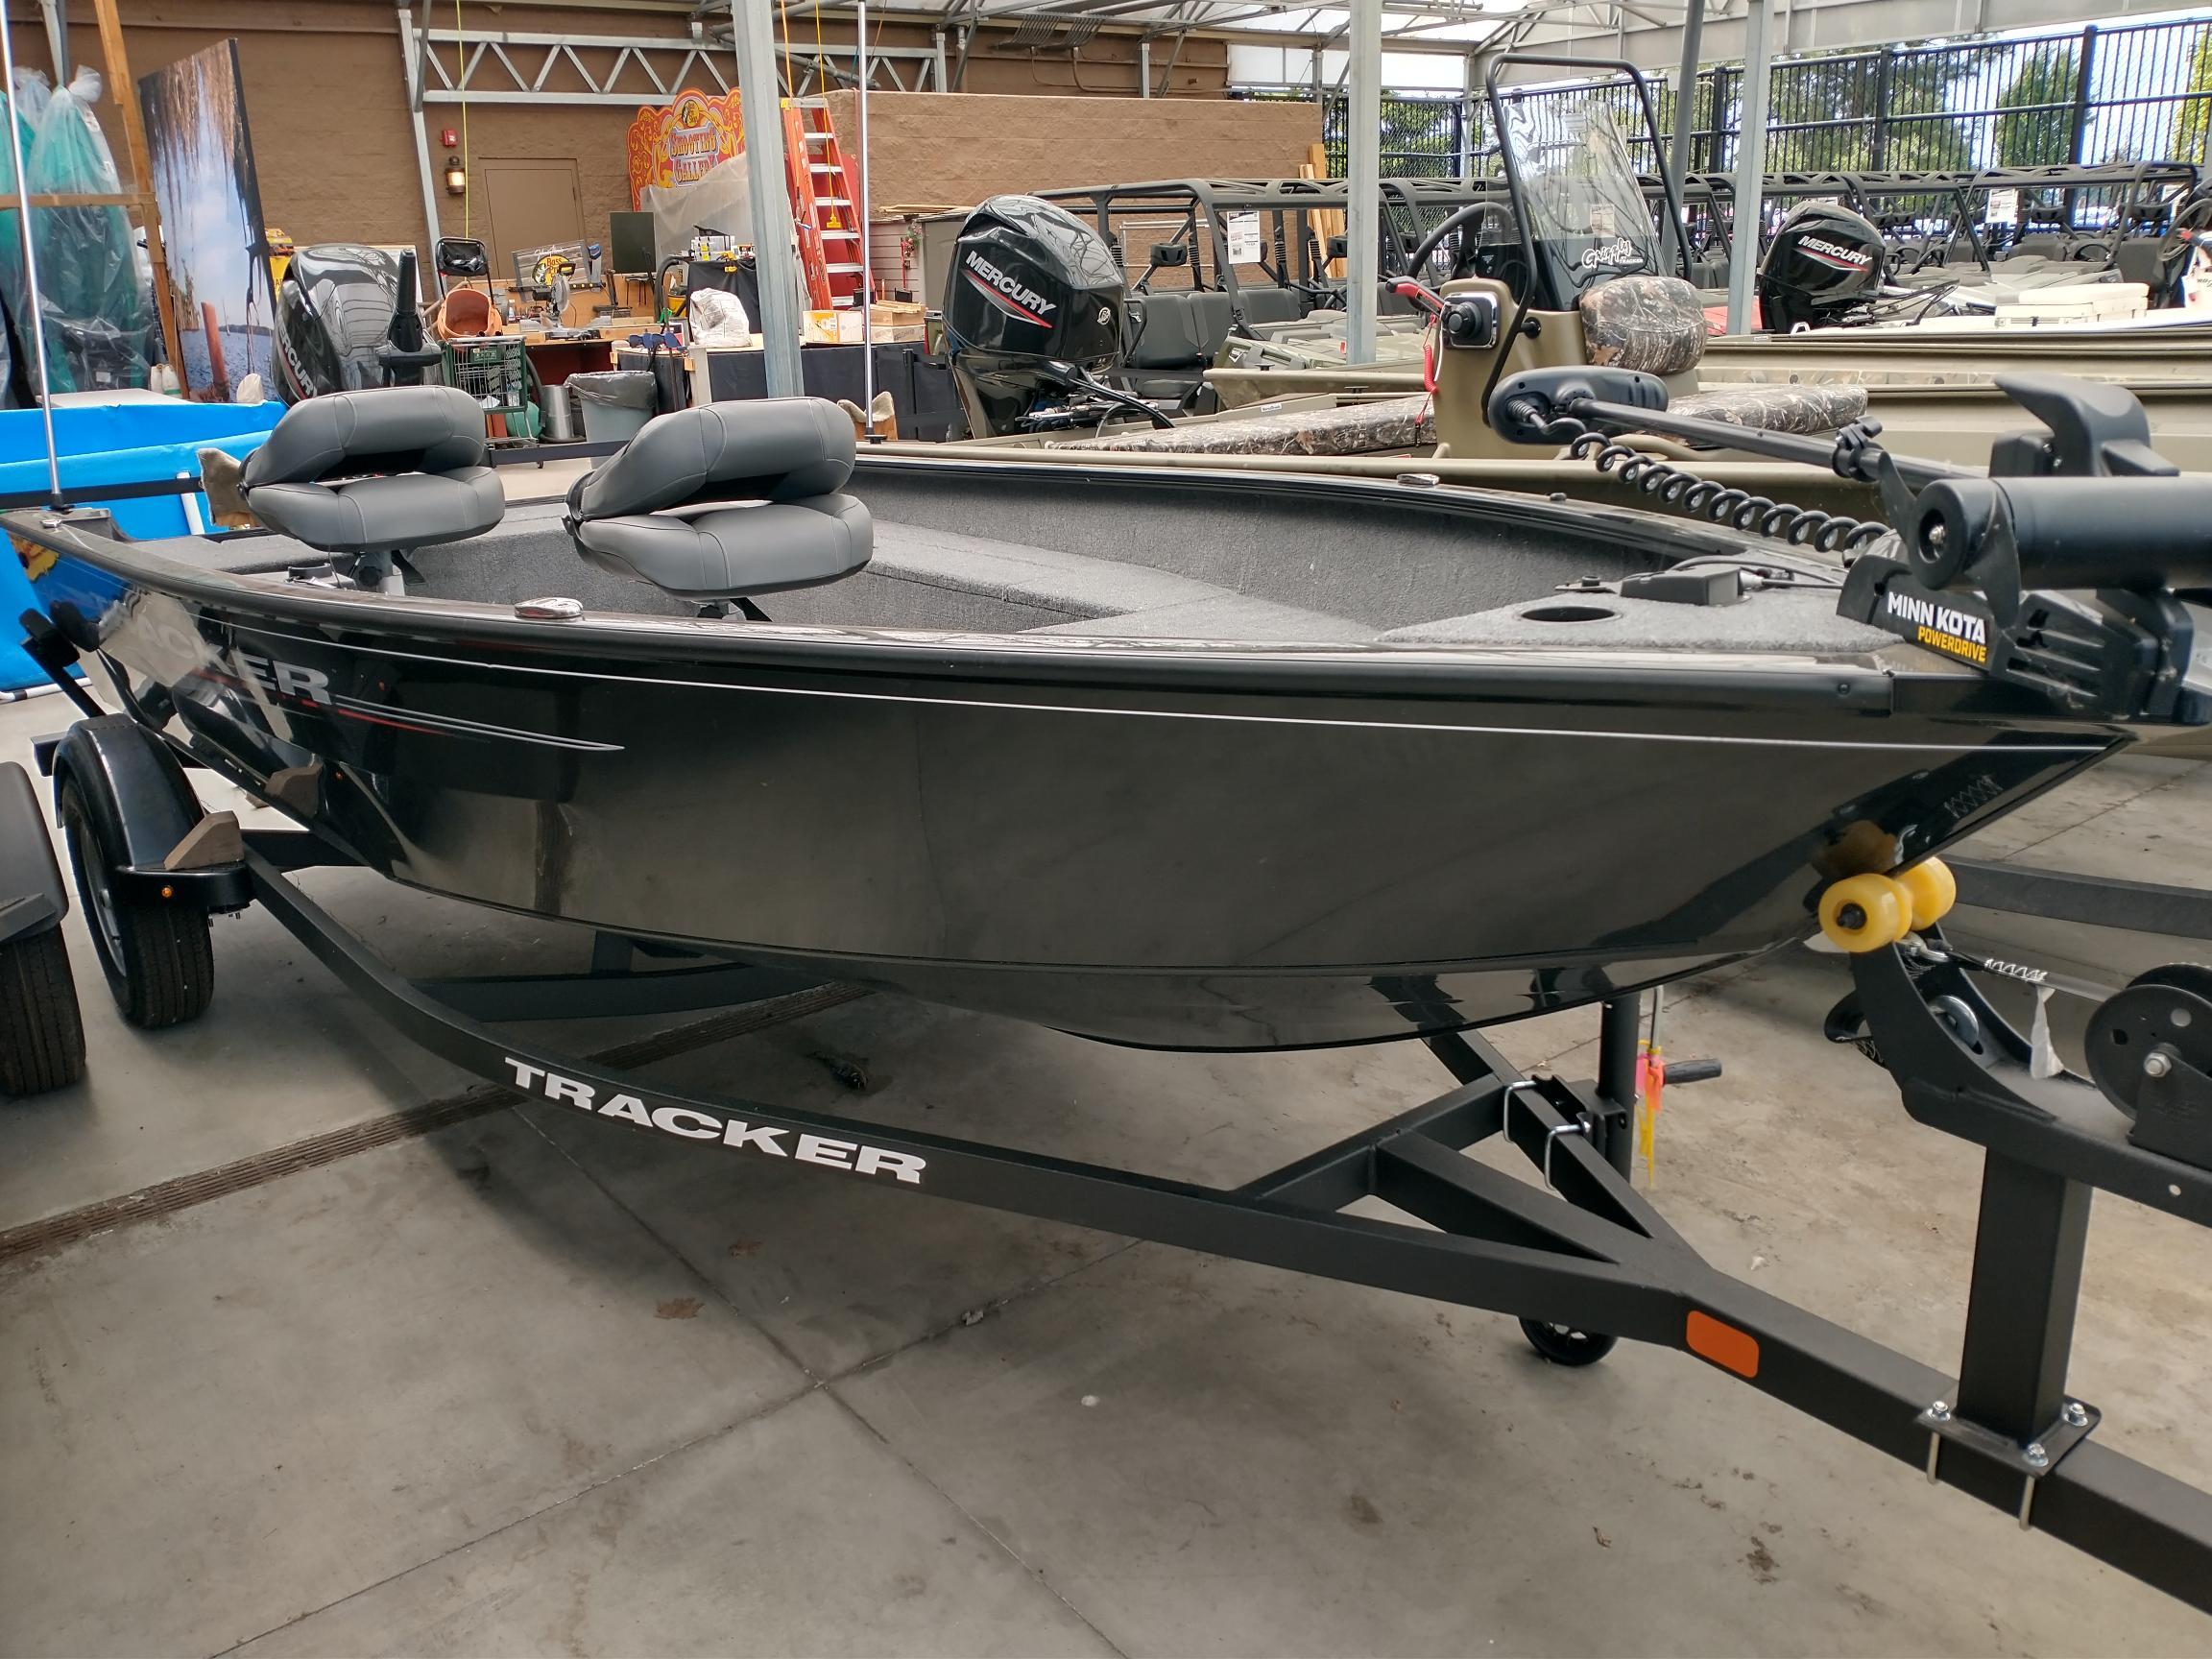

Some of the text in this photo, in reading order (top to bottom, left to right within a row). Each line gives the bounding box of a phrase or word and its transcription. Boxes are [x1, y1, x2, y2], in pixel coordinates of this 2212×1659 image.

[671, 130, 717, 156] SHOOTING
[1798, 235, 1873, 265] MERCURY
[965, 251, 1057, 315] MERCURY
[1887, 591, 1986, 644] MINN KOTA
[1917, 625, 1987, 662] POWERDRIVE
[505, 1057, 926, 1184] TRACKER
